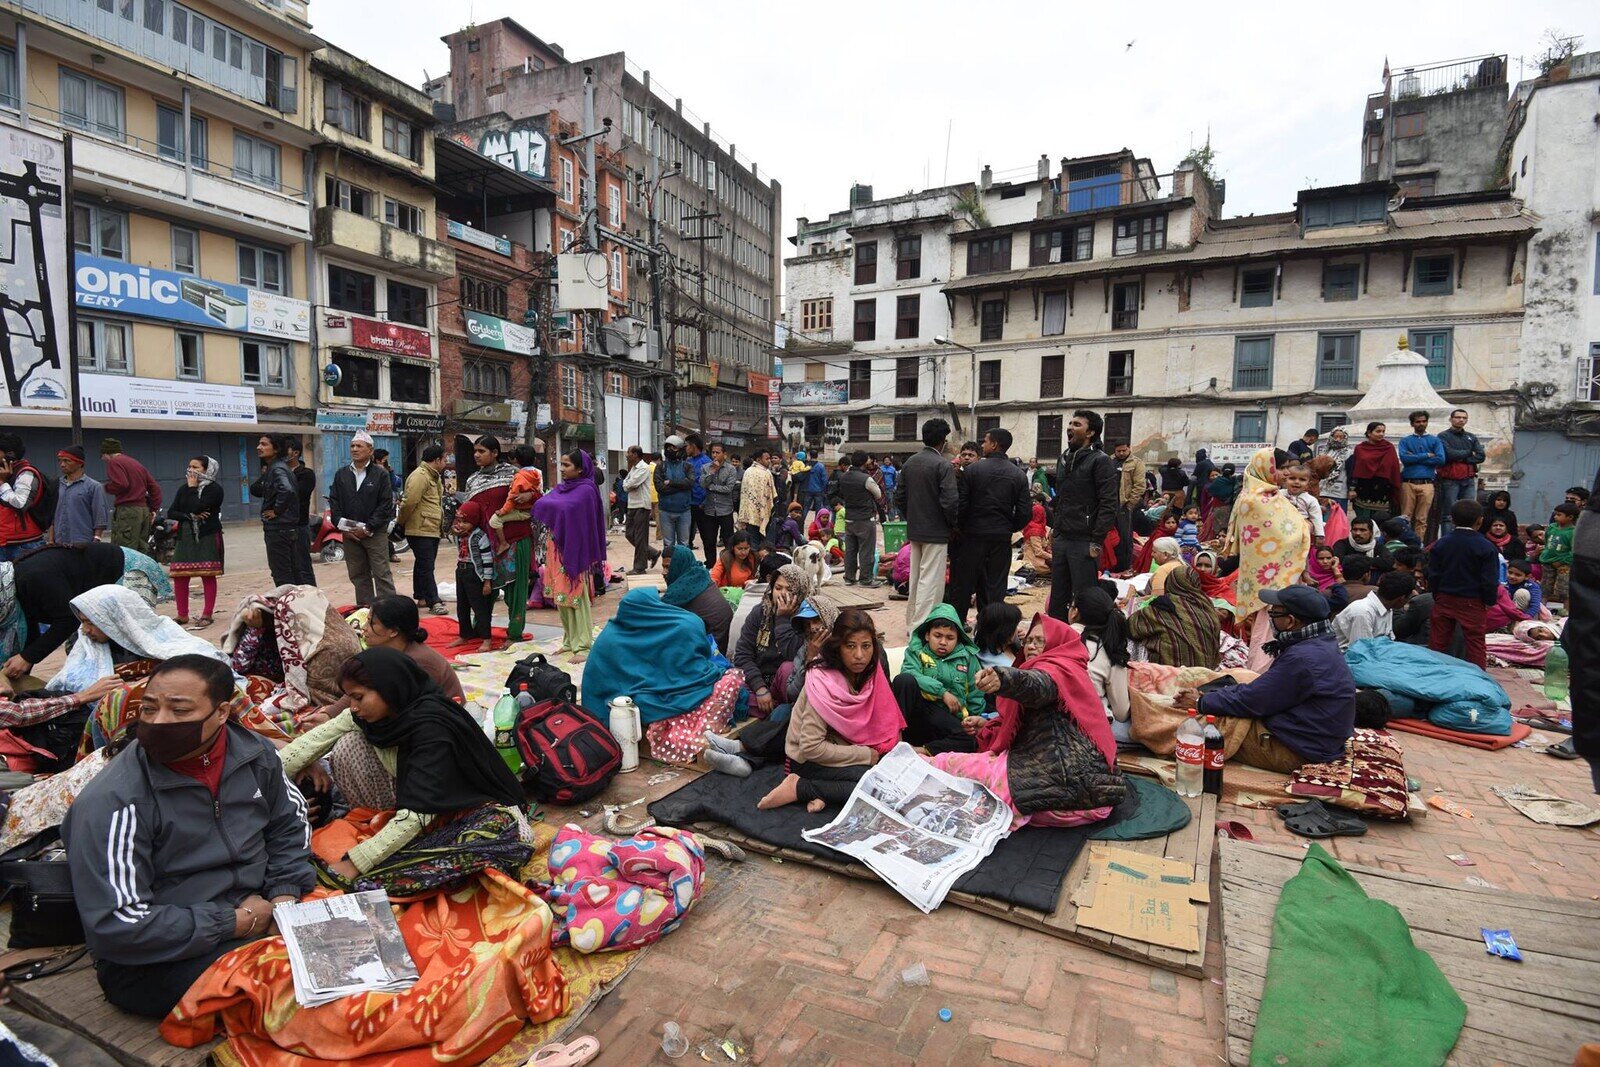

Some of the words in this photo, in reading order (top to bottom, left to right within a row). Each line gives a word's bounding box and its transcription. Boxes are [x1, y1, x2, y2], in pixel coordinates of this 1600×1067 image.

[76, 266, 179, 305] onic
[75, 291, 125, 308] TERY
[467, 319, 503, 341] Carlsberg
[129, 398, 168, 407] SHOWROOM
[174, 400, 205, 409] CORPORATE
[207, 402, 226, 410] OFFICE
